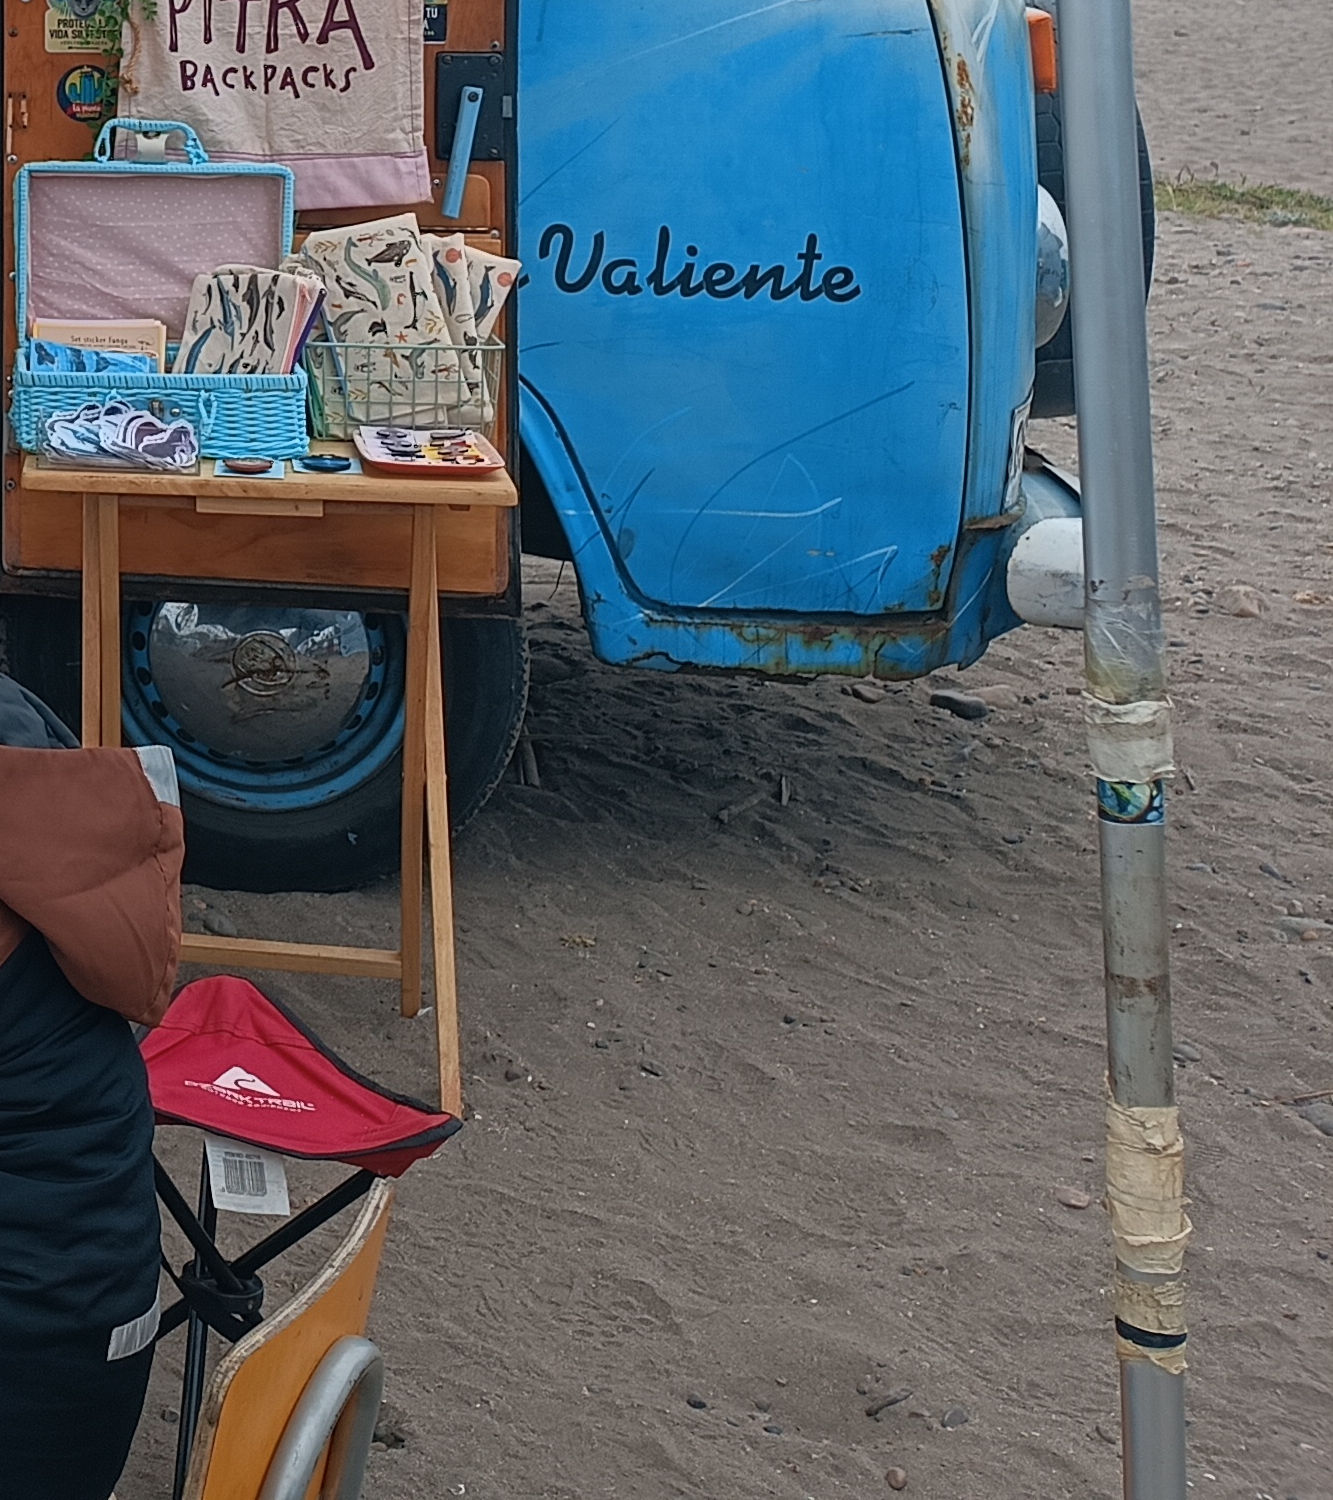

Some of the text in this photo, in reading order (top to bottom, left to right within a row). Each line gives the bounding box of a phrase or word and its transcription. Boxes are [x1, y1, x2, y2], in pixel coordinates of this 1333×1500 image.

[425, 7, 438, 19] TU
[178, 58, 358, 100] BACKPACKS
[538, 223, 862, 303] Valiente
[71, 335, 82, 344] Set
[84, 335, 106, 344] sticker
